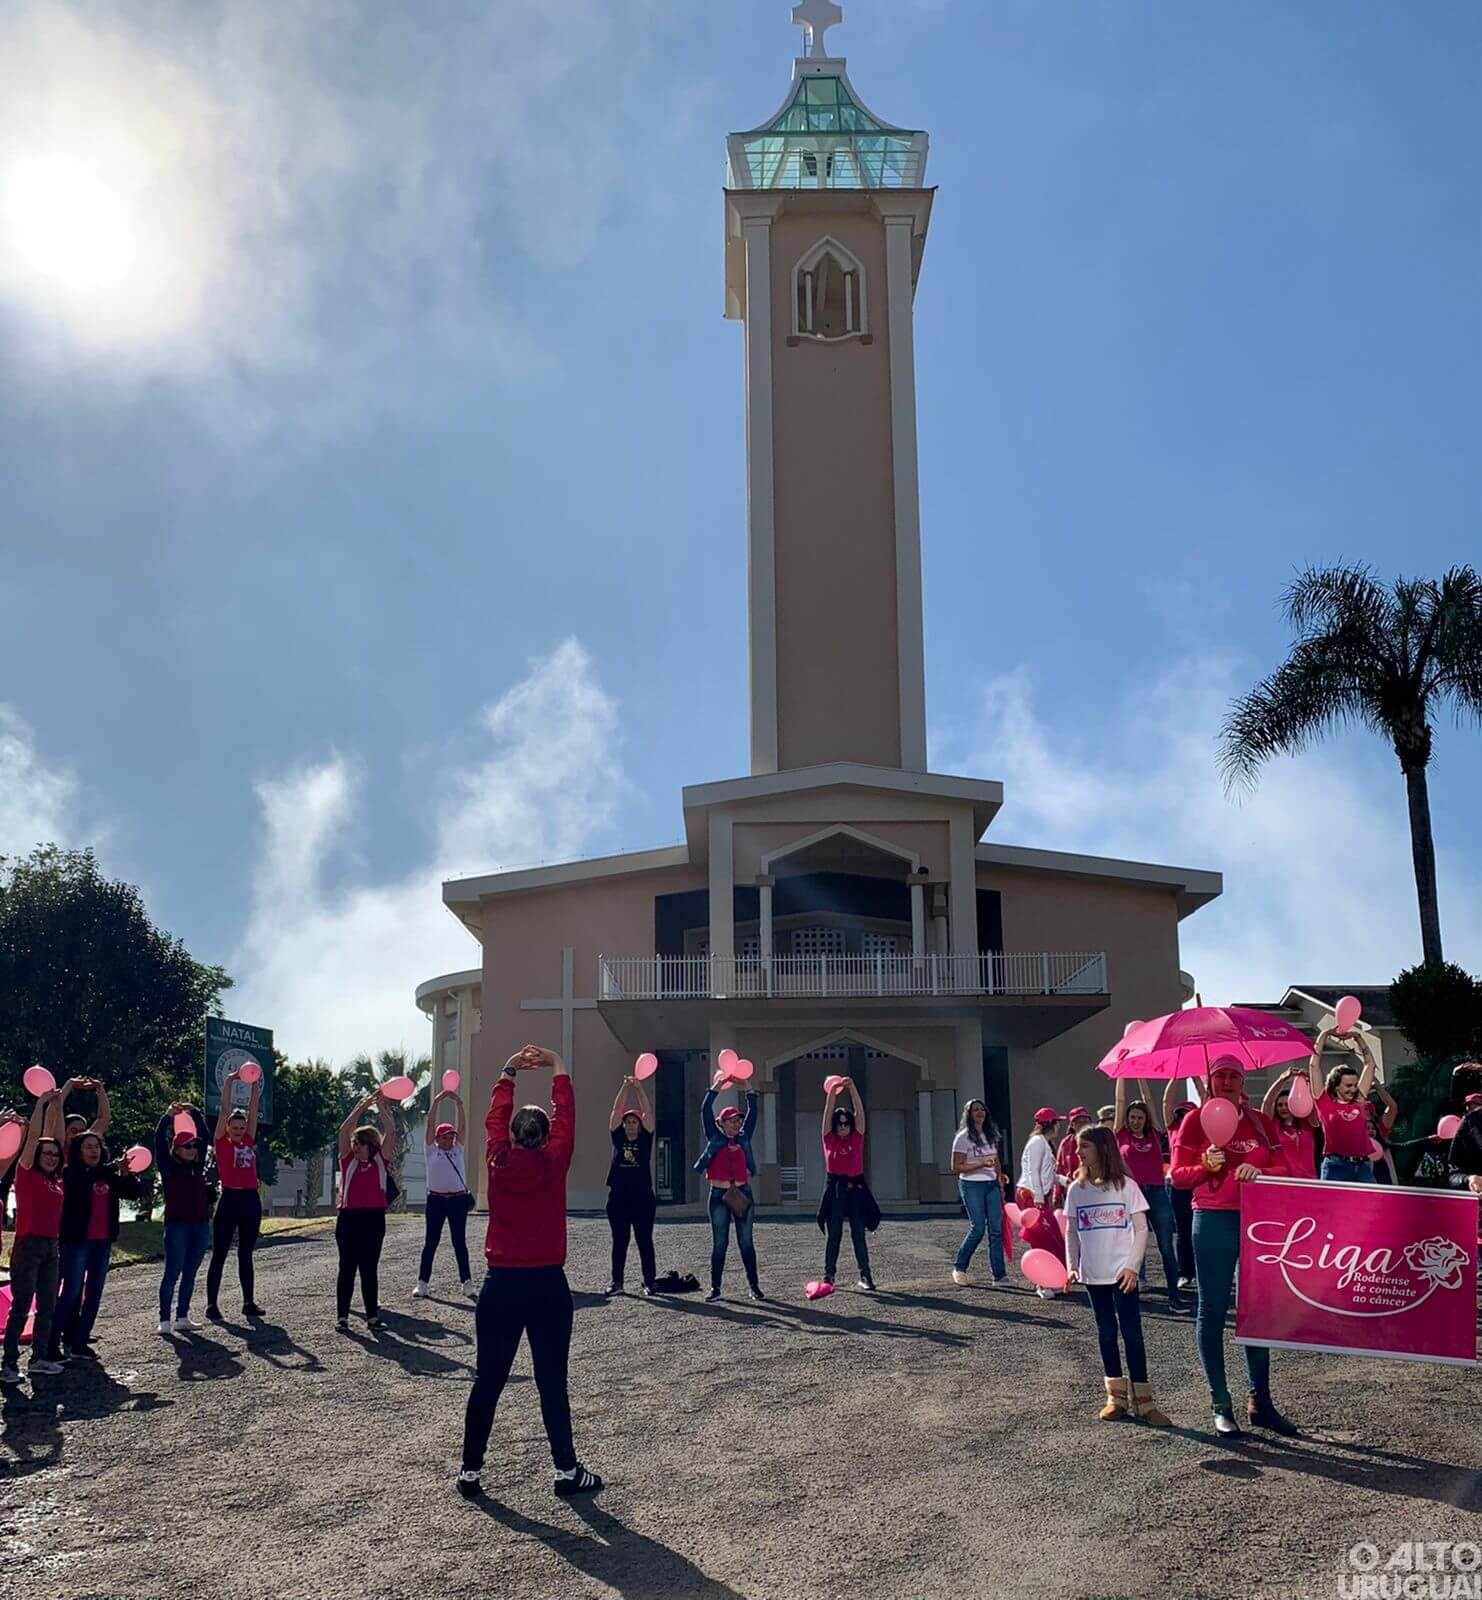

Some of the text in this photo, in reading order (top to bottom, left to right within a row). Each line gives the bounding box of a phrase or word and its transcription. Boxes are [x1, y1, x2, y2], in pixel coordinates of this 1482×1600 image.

[222, 1025, 258, 1043] NATAL
[1247, 1217, 1404, 1289] Liga
[1353, 1272, 1410, 1286] Rodeiense
[1352, 1283, 1417, 1297] de combate
[1352, 1295, 1407, 1307] ao câncer
